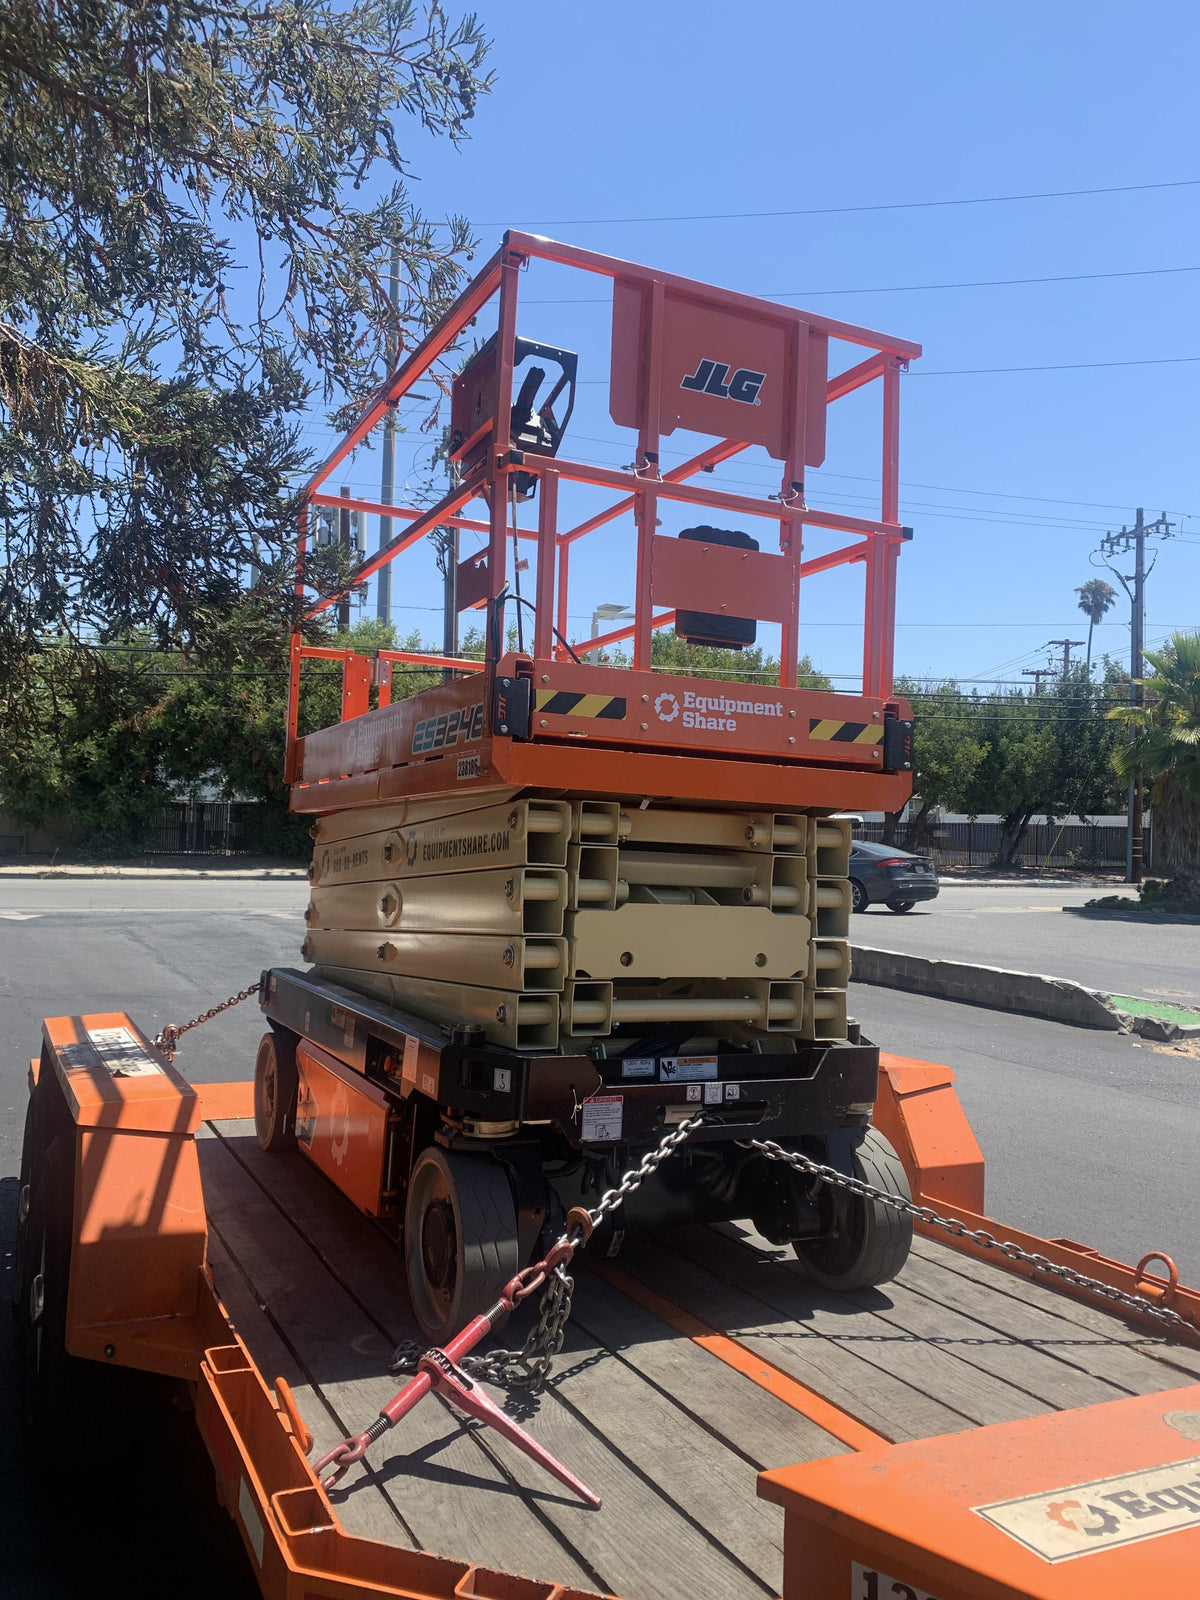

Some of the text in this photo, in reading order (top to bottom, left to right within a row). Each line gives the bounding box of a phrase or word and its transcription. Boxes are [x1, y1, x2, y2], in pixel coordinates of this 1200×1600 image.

[680, 358, 767, 405] JLG
[683, 691, 783, 717] Equipment
[358, 713, 403, 742] Equipment
[682, 711, 737, 732] Share
[357, 747, 380, 765] Share
[422, 830, 510, 862] EQUIPMENTSHARE.COM
[1100, 1473, 1200, 1520] Equ
